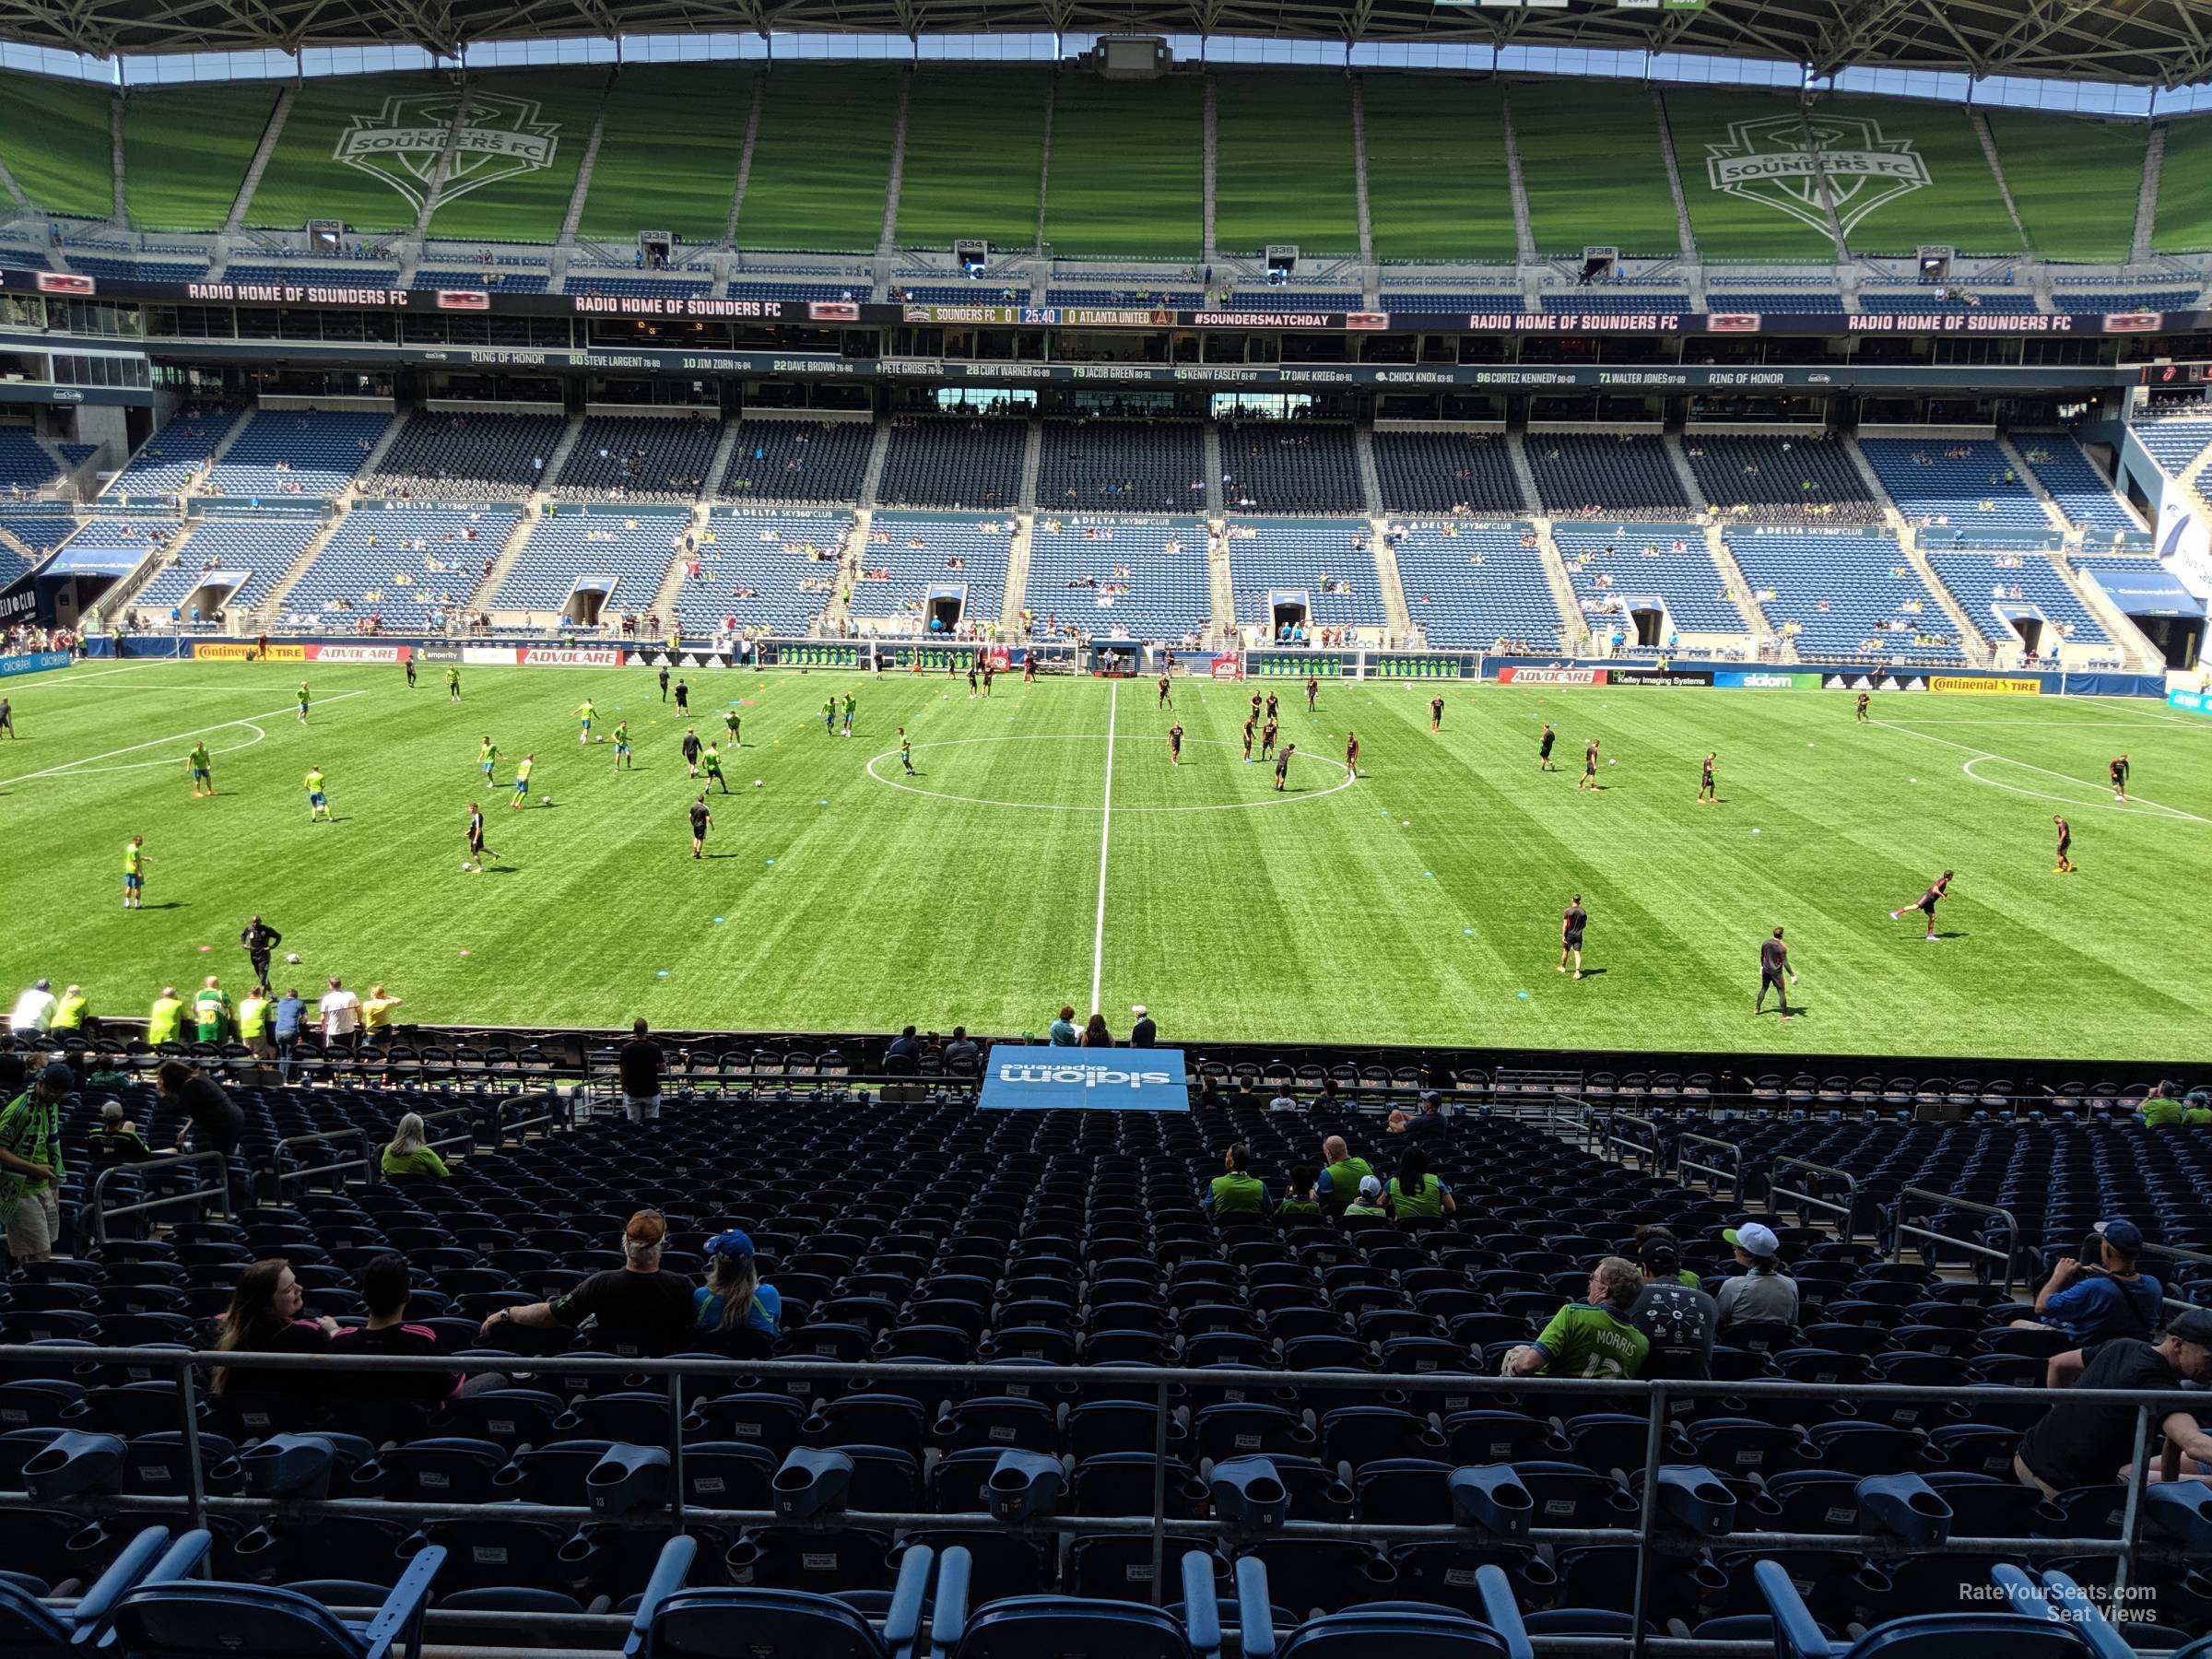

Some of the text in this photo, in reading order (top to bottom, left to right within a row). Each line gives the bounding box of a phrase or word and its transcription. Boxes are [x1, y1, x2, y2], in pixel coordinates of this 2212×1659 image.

[511, 144, 543, 158] FC
[1877, 161, 1911, 175] FC
[644, 231, 668, 240] 332
[959, 241, 982, 249] 334
[188, 284, 408, 305] RADIO HOME OF SOUNDERS FC
[576, 297, 782, 316] RADIO HOME OF SOUNDERS FC
[936, 308, 982, 322] SOUNDERS
[984, 309, 995, 322] FC
[1005, 309, 1012, 322] 0
[1025, 309, 1055, 324] 25:40
[1069, 310, 1149, 324] 0 ATLANTA UNITED
[1194, 313, 1329, 326] #SOUNDERSMATCHDAY
[1469, 314, 1678, 330] RADIO HOME OF SOUNDERS FC
[1848, 315, 2072, 330] RADIO HOME OF SOUNDERS FC
[471, 353, 546, 364] RING OF HONOR
[583, 356, 608, 366] STEVE
[608, 356, 642, 367] LARGENT
[683, 359, 696, 368] 10
[696, 359, 712, 369] JIM
[712, 359, 734, 370] ZORN
[774, 360, 787, 370] 22
[787, 360, 806, 371] DAVE
[806, 361, 836, 371] BROWN
[882, 364, 900, 374] PETE
[901, 364, 926, 374] GROSS
[980, 365, 999, 375] CURT
[1001, 366, 1032, 376] WARNER
[1072, 367, 1086, 377] 79
[1086, 367, 1109, 378] JACOB
[1110, 368, 1135, 379] GREEN
[1174, 369, 1188, 379] 45
[1188, 370, 1214, 380] KENNY
[1215, 370, 1241, 381] EASLEY
[1280, 371, 1291, 381] 17
[1291, 371, 1311, 382] DAVE
[1312, 371, 1335, 382] KRIEG
[1389, 371, 1415, 382] CHUCK
[1416, 372, 1438, 382] KNOX
[1477, 372, 1491, 382] 96
[1491, 372, 1520, 383] CORTEZ
[1521, 373, 1558, 383] KENNEDY
[1599, 372, 1611, 382] 71
[1611, 373, 1641, 383] WALTER
[1642, 373, 1668, 383] JONES
[1709, 373, 1783, 383] RING OF HONOR
[396, 501, 433, 510] DELTA
[743, 508, 777, 516] DELTA
[276, 649, 301, 657] TIRE
[320, 649, 396, 659] ADVOCARE
[428, 651, 458, 660] amperity
[527, 651, 616, 663] ADVOCARE
[1514, 671, 1594, 682] ADVOCARE
[1618, 676, 1706, 686] Kelley Imaging Systems
[1743, 674, 1792, 688] slalom
[1934, 677, 1998, 691] Continental
[2012, 683, 2036, 691] TIRE
[999, 1070, 1171, 1088] slalom
[1596, 1329, 1637, 1357] MORRIS
[595, 1497, 605, 1507] 13
[783, 1501, 793, 1512] 12
[1001, 1503, 1008, 1512] 11
[1264, 1513, 1272, 1524] 10
[1712, 1517, 1720, 1527] 8
[1511, 1520, 1517, 1530] 9
